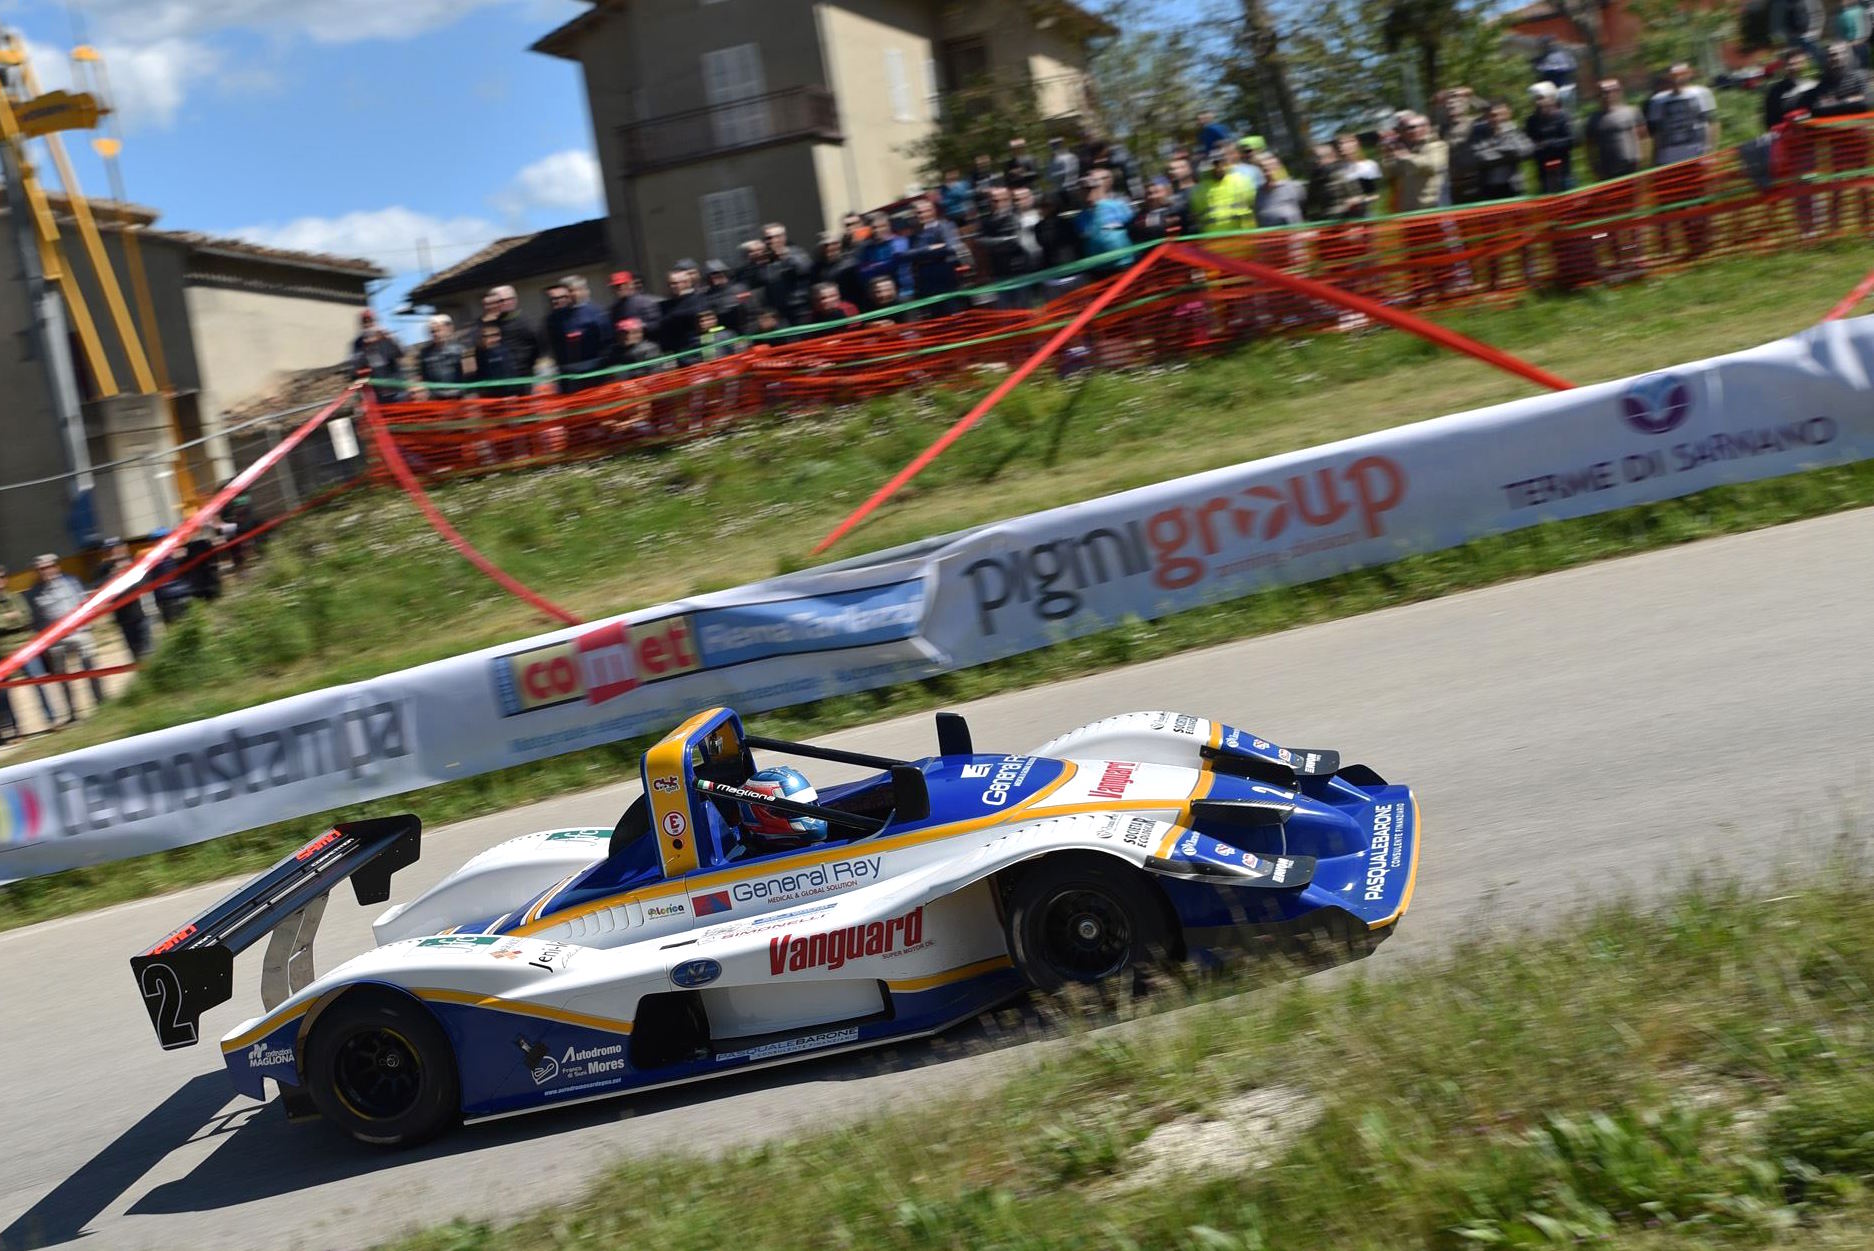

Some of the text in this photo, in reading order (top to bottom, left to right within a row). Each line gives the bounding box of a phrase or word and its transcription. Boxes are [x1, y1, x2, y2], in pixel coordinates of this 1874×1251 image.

[1622, 450, 1666, 484] DI
[1673, 415, 1839, 473] SARNANO
[521, 624, 697, 700] comet
[716, 783, 776, 802] magliona
[982, 763, 1024, 806] General
[1088, 761, 1136, 799] Vanguard
[1252, 786, 1295, 800] 2
[669, 815, 680, 829] E
[1364, 804, 1392, 901] PASQUALEBARONE
[1391, 833, 1403, 868] CONSULENTE
[732, 856, 882, 902] General Ray
[767, 892, 793, 904] MEDICAL
[794, 891, 799, 899] &
[800, 886, 825, 898] GLOBAL
[769, 906, 924, 976] Vanguard
[142, 963, 198, 1051] 2
[250, 1054, 295, 1068] MAGLIONA
[561, 1044, 622, 1064] Autodromo
[588, 1058, 625, 1075] Mores
